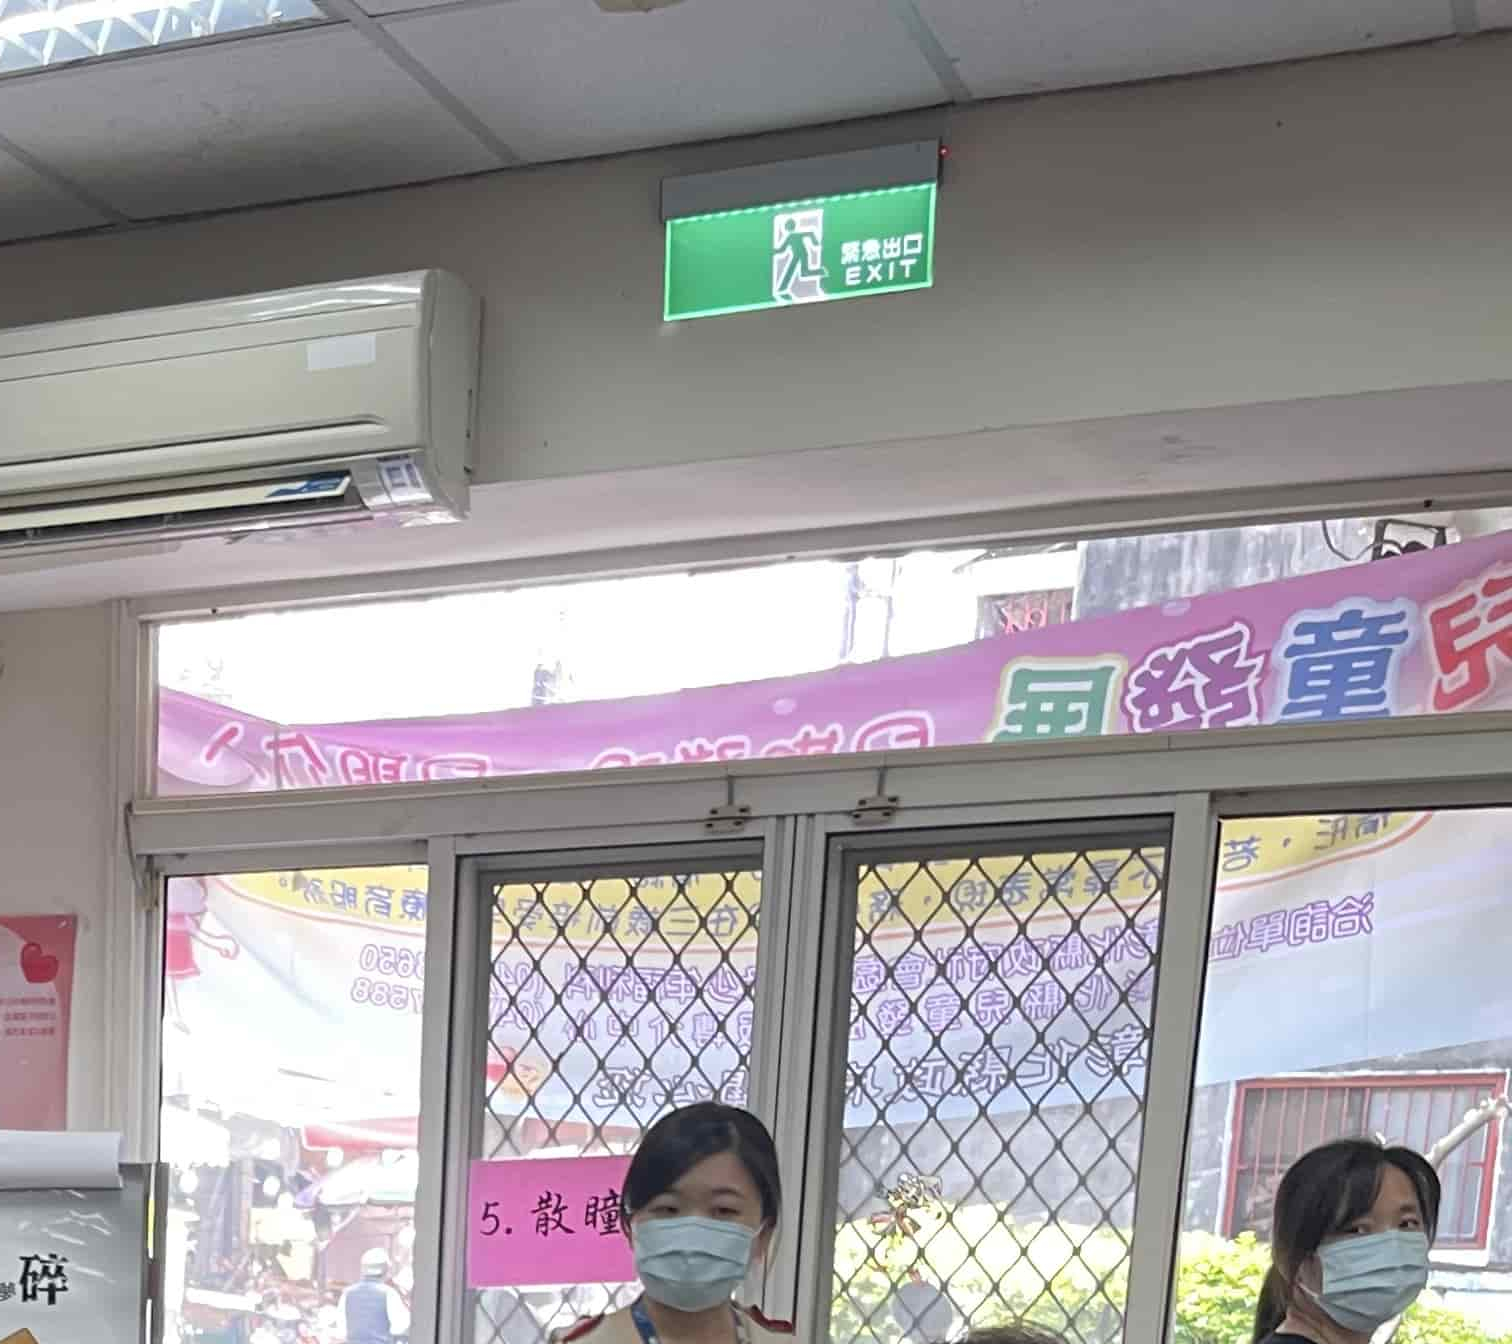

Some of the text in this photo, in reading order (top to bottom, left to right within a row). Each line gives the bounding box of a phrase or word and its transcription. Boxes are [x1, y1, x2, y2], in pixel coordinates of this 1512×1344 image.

[841, 233, 923, 265] 緊急出口
[845, 258, 919, 286] EXIT
